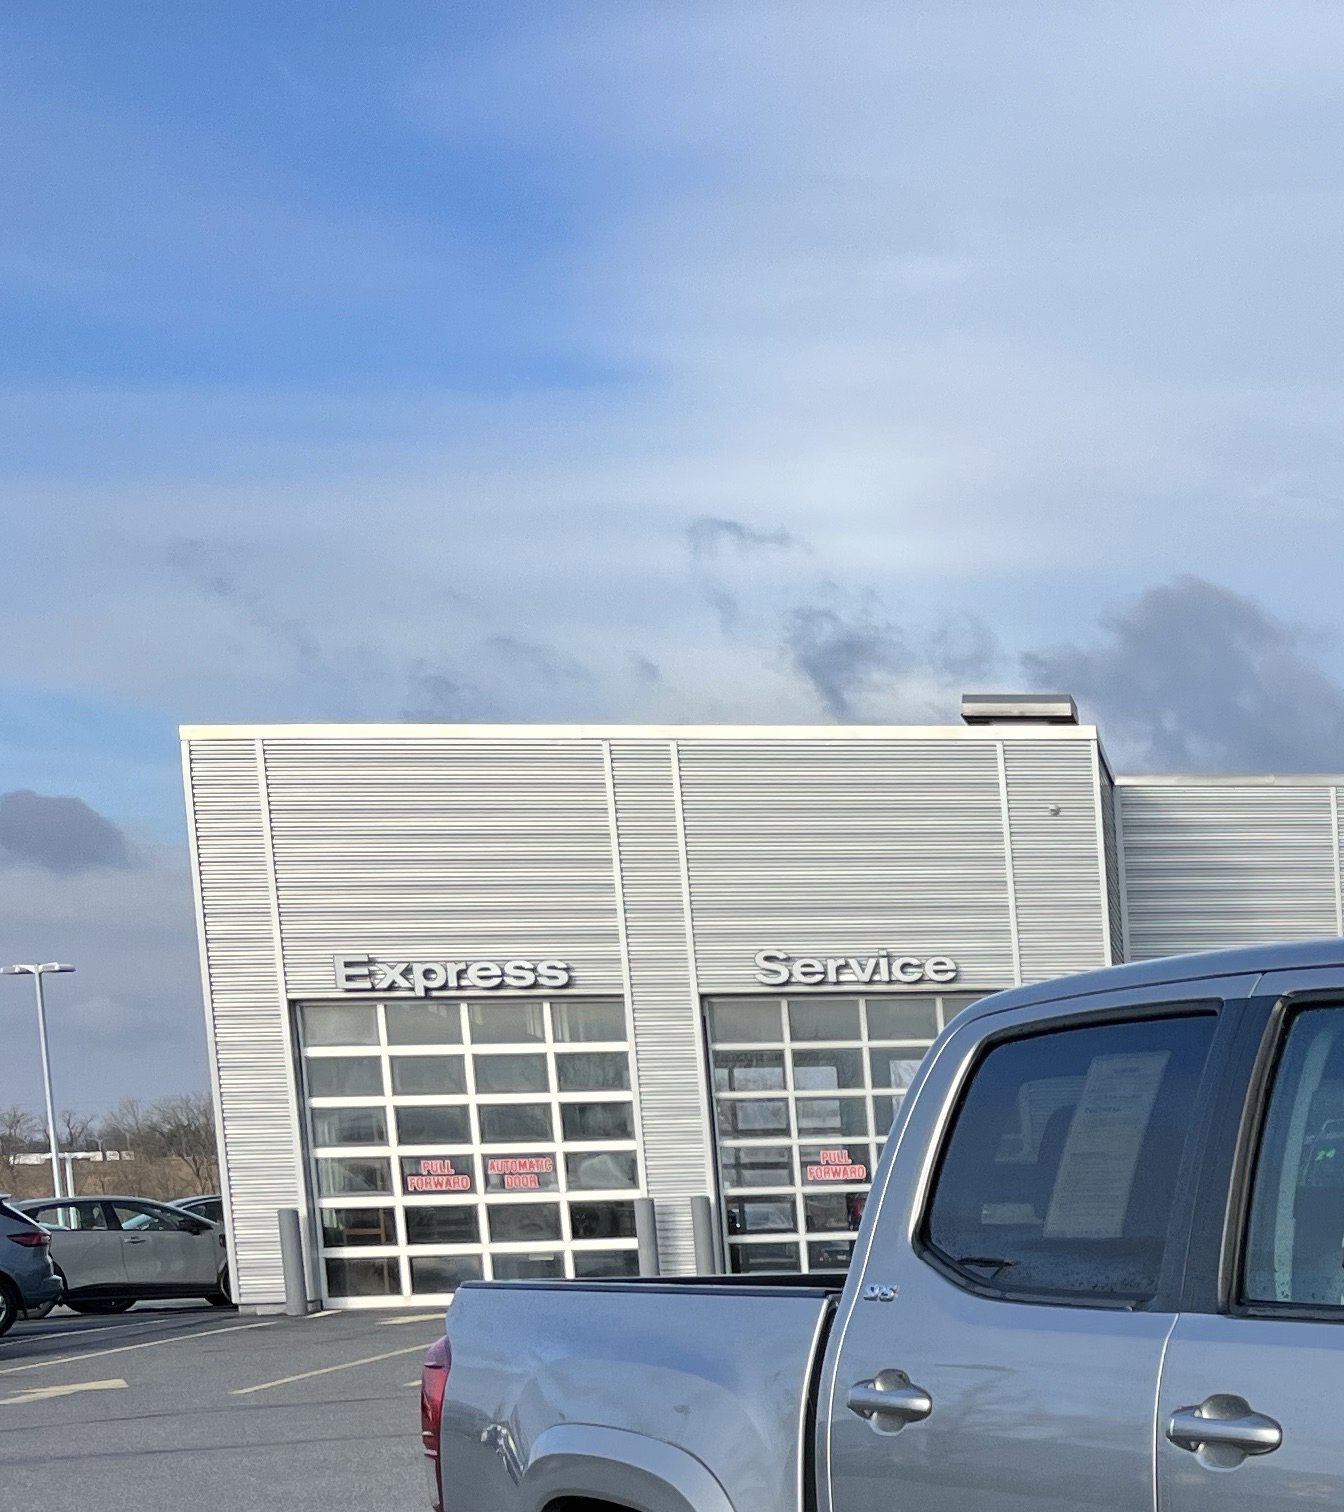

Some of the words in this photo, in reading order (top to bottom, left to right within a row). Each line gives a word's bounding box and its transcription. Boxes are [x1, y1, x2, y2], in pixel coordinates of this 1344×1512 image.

[333, 953, 572, 997] Express
[754, 948, 957, 985] Service
[487, 1156, 553, 1174] AUTOMATIC
[820, 1149, 852, 1165] PULL
[420, 1159, 455, 1175] PULL
[806, 1164, 867, 1181] FORWARD
[406, 1174, 471, 1191] FORWARD
[503, 1173, 540, 1190] DOOR
